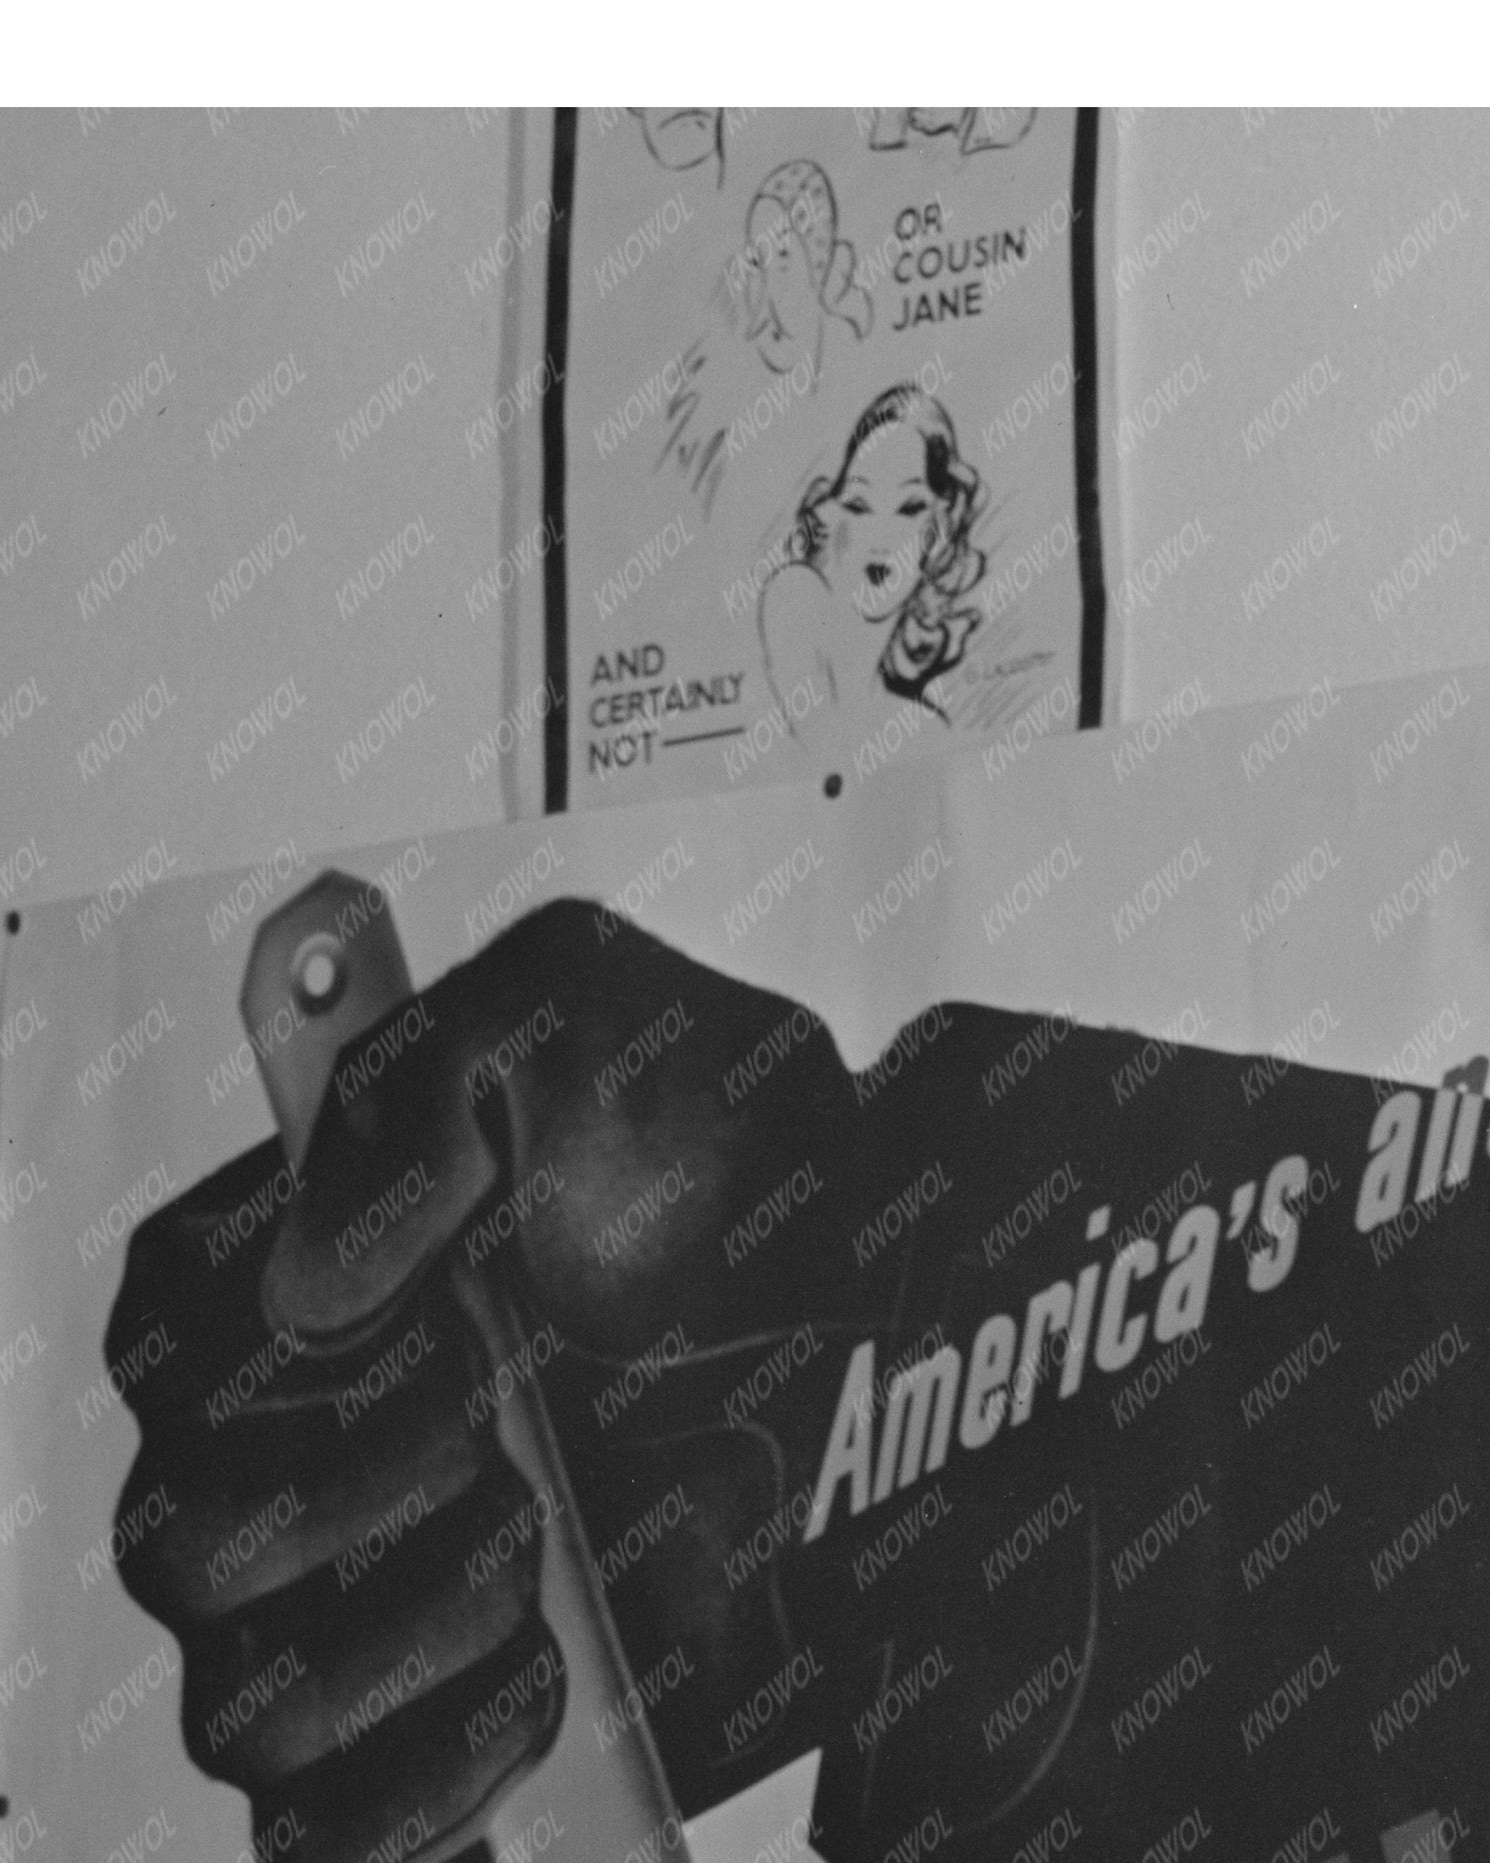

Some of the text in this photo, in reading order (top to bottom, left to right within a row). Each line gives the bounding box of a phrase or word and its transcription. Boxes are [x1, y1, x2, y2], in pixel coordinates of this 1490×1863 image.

[895, 203, 944, 242] OR
[892, 227, 1028, 285] COUSIN
[891, 281, 985, 332] JANE
[589, 643, 666, 688] AND
[587, 670, 746, 728] CERTAINLY
[802, 1153, 1309, 1546] America's
